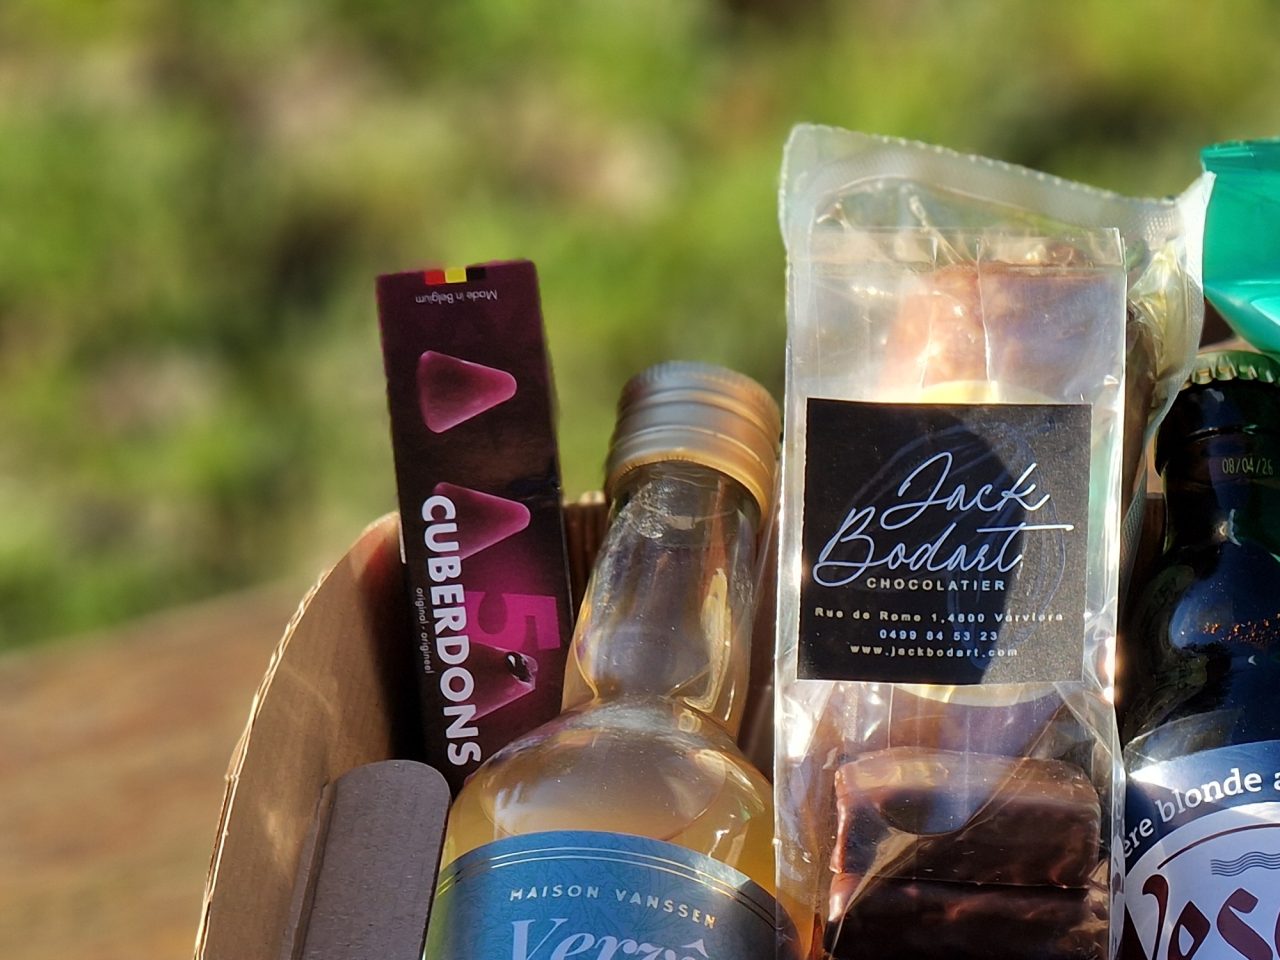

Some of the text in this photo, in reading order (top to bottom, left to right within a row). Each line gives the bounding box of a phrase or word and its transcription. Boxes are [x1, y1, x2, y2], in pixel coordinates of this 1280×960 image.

[415, 289, 498, 304] Made in Belgium
[880, 452, 1050, 530] Jack
[813, 506, 1074, 587] Bodart
[866, 577, 1006, 591] CHOCOLATIER
[415, 587, 436, 674] original origineel
[422, 494, 482, 767] CUBERDONS
[814, 607, 844, 619] Rue
[852, 609, 871, 620] de
[879, 611, 922, 622] Rome
[879, 629, 998, 641] 0499 84 53 23
[850, 645, 1018, 658] www.jackbodart.com
[1155, 768, 1263, 824] blonde
[509, 884, 717, 930] MAISON VANSSEN
